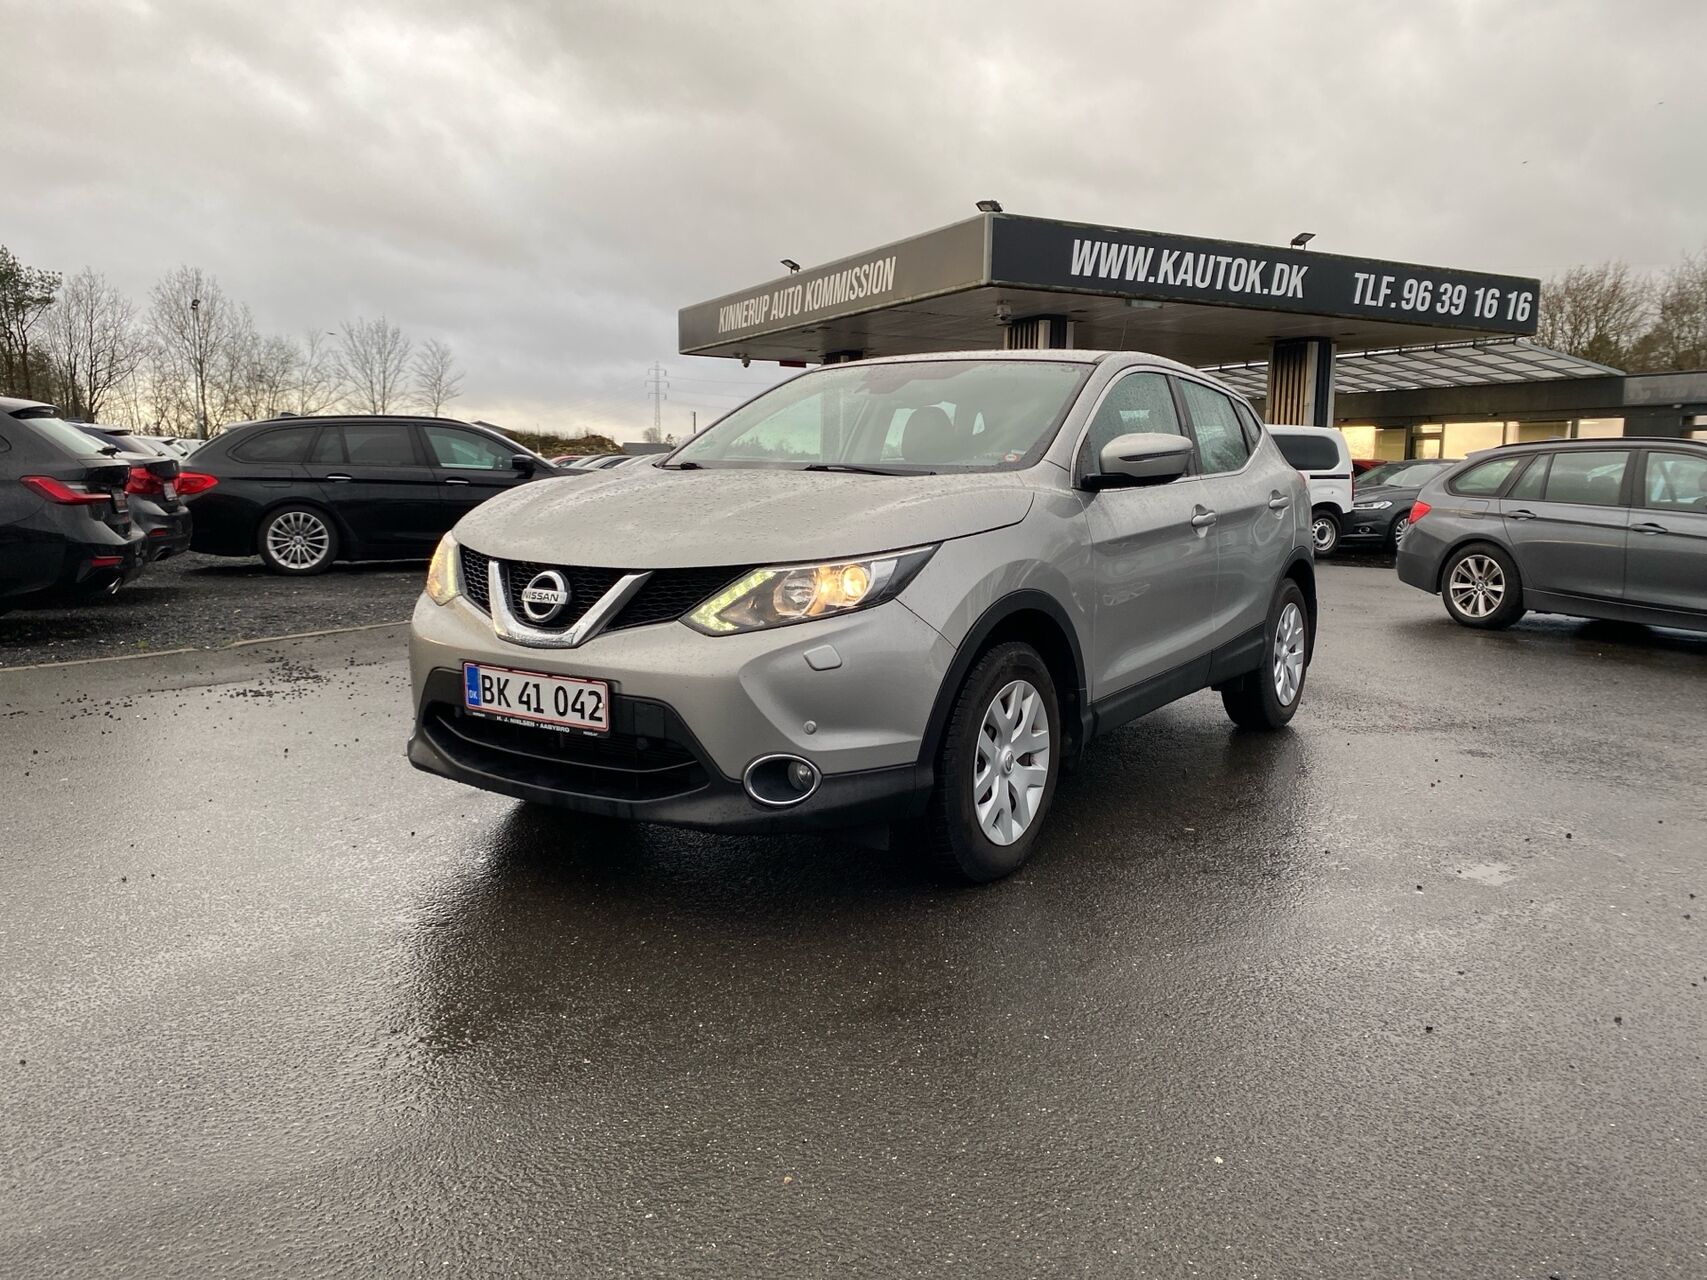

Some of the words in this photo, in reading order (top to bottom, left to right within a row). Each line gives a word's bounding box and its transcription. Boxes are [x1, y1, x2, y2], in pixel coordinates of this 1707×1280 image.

[1070, 239, 1309, 298] WWW.KAUTOK.DK
[718, 294, 770, 334] KINNERUP
[770, 284, 802, 321] AUTO
[804, 256, 897, 312] KOMMISSION
[1353, 272, 1396, 308] TLF.
[1401, 278, 1433, 312] 96
[1436, 283, 1467, 315] 39
[1474, 287, 1500, 319] 16
[1507, 291, 1533, 322] 16
[525, 590, 559, 602] NISSAN
[469, 690, 478, 699] DK
[481, 674, 511, 708] BK
[518, 681, 544, 714] 41
[554, 685, 603, 722] 042
